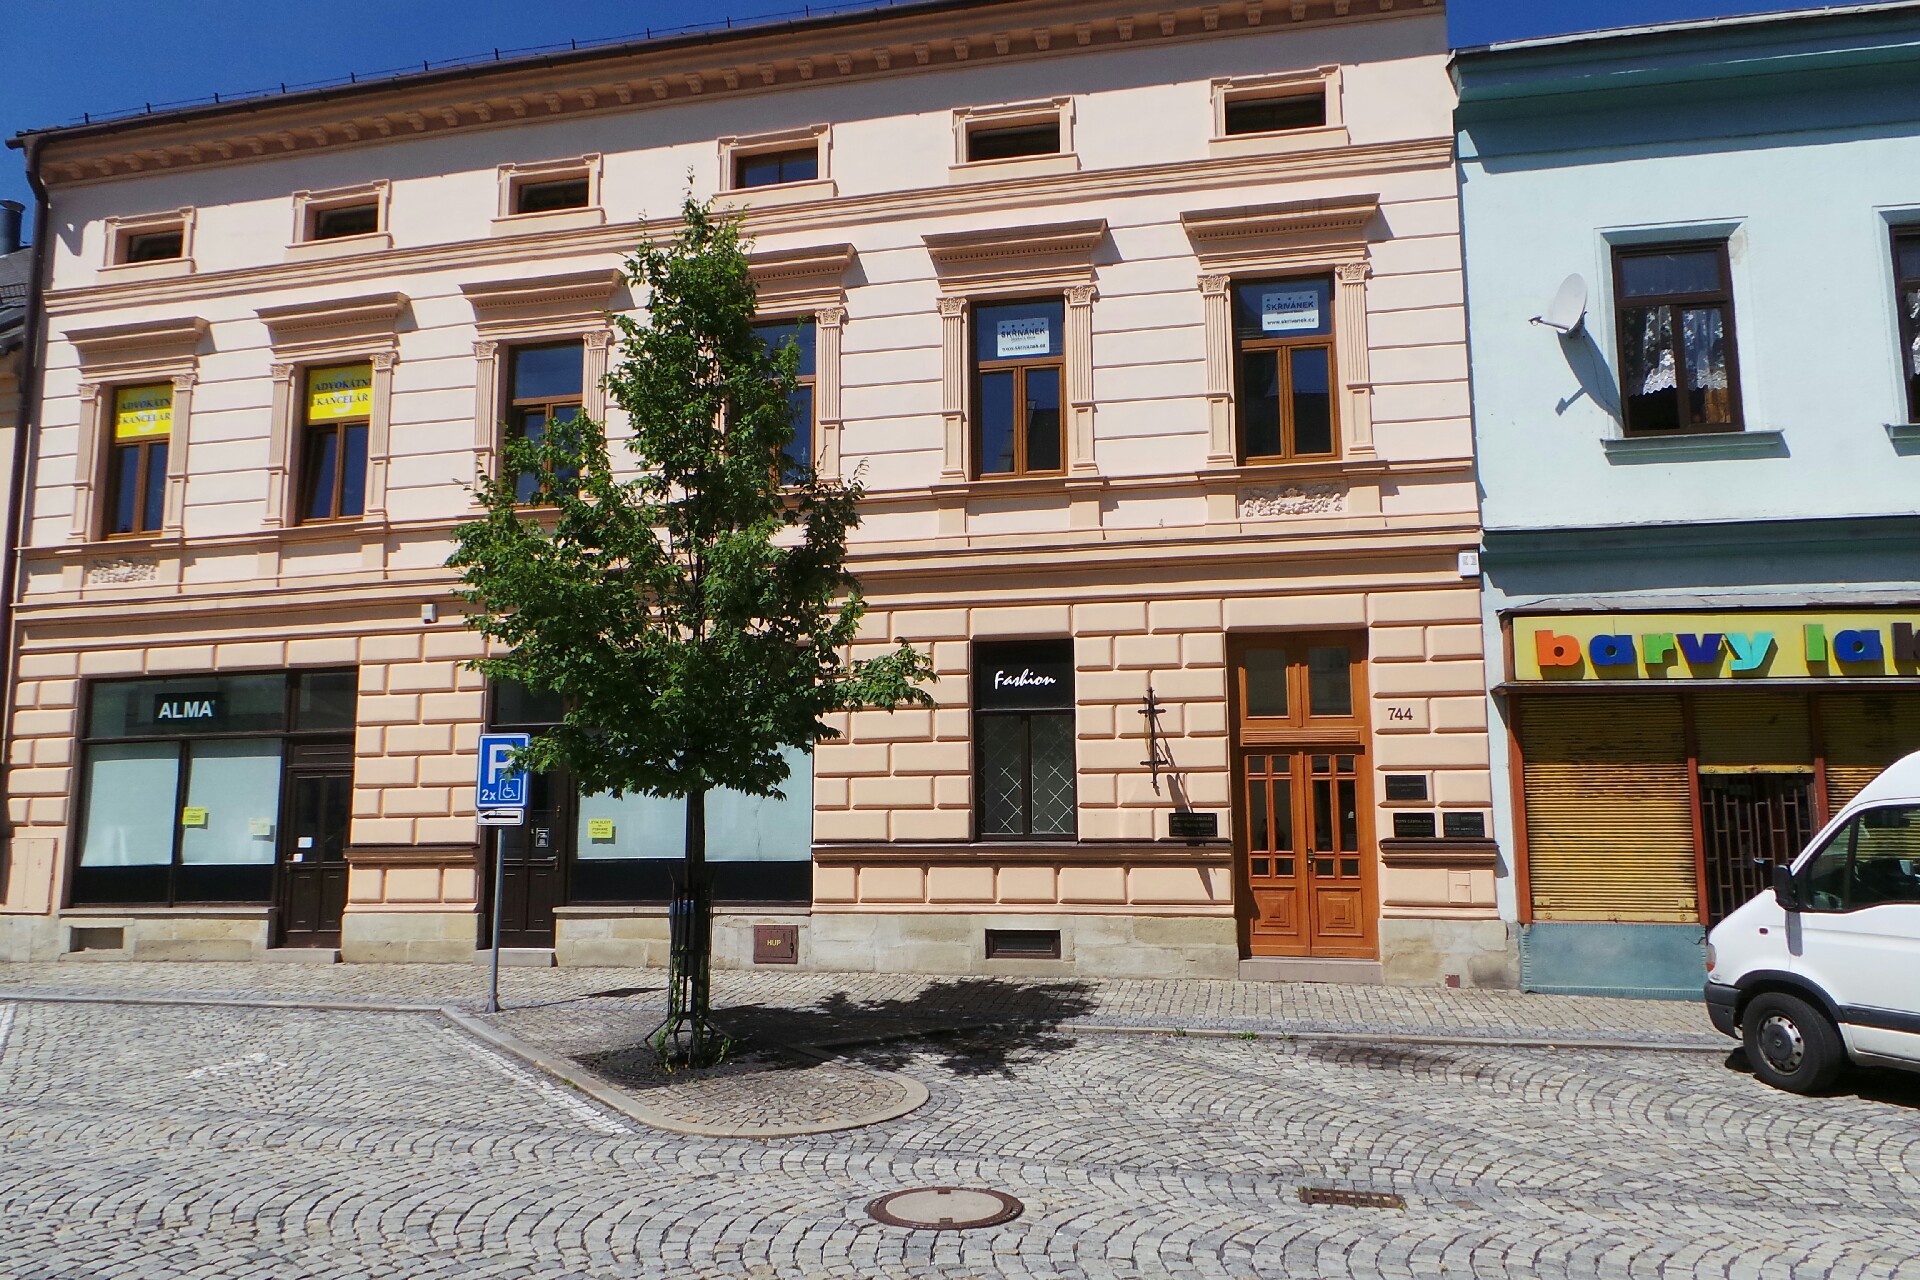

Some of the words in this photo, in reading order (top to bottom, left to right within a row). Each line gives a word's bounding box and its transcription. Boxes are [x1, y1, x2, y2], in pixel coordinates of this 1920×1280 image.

[1535, 629, 1776, 671] barvy
[994, 668, 1057, 690] Fashion
[158, 700, 212, 719] ALMA
[1387, 707, 1413, 720] 744
[488, 743, 516, 785] P
[481, 789, 497, 801] 2x
